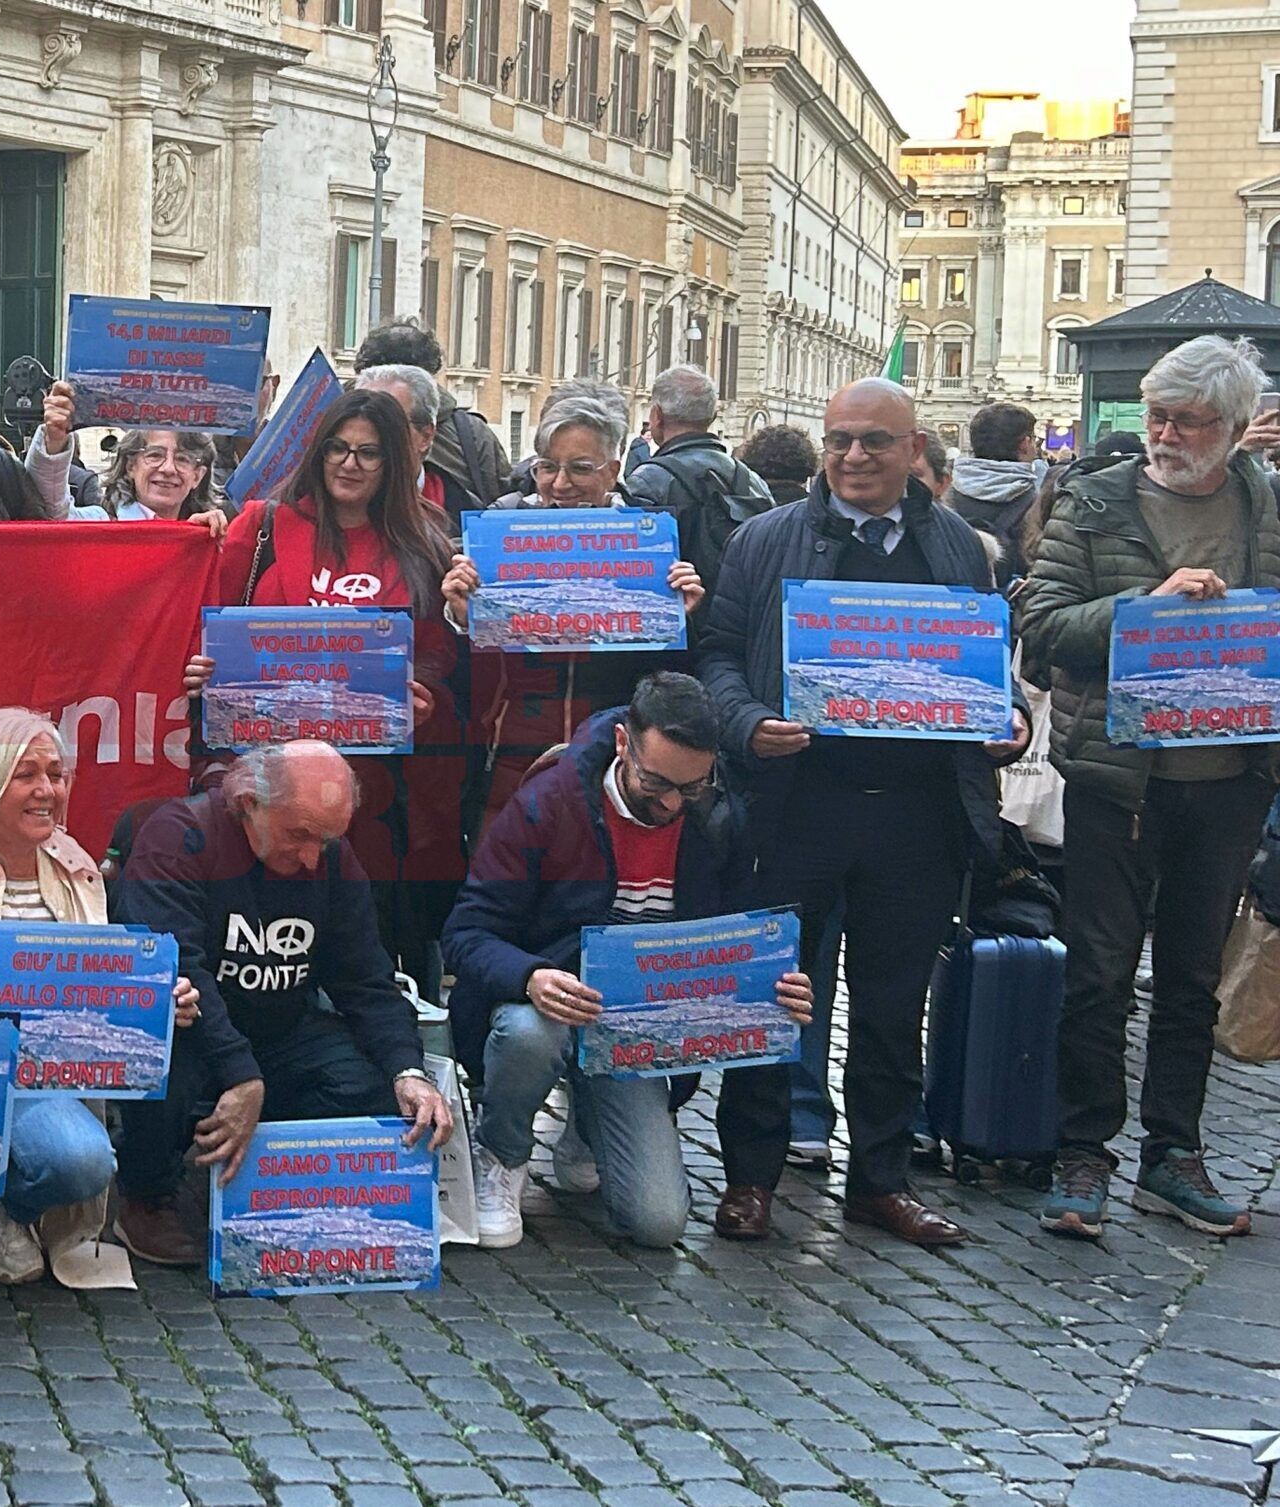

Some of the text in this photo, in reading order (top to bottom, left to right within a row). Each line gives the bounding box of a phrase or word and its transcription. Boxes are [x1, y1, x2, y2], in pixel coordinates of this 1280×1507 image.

[107, 323, 231, 344] 14,6 MILIARDI
[127, 349, 206, 367] DI TASSE
[119, 373, 209, 391] PER TUTTI
[96, 402, 218, 423] NO PONTE
[503, 534, 639, 553] SIAMO TUTTI
[497, 560, 654, 581] ESPROPRIANDI
[511, 612, 644, 635] NO PONTE
[794, 613, 832, 630] TRA
[835, 615, 899, 633] SCILLA
[902, 616, 913, 633] E
[250, 634, 364, 653] VOGLIAMO
[830, 639, 961, 660] SOLO IL MARE
[260, 663, 350, 682] L'ACQUA
[826, 698, 967, 725] NO PONTE
[1143, 705, 1272, 732] NO PONTE
[232, 719, 271, 740] NO
[298, 719, 382, 740] PONTE
[225, 912, 315, 961] NO
[56, 952, 78, 972] LE
[81, 953, 134, 973] MANI
[636, 943, 753, 972] VOGLIAMO
[216, 959, 310, 991] PONTE
[63, 985, 156, 1008] STRETTO
[645, 975, 737, 1001] L'ACQUA
[612, 1043, 655, 1066] NO
[681, 1027, 767, 1057] PONTE
[42, 1062, 127, 1086] PONTE
[258, 1151, 397, 1177] SIAMO TUTTI
[250, 1184, 411, 1210] ESPROPRIANDI
[261, 1246, 396, 1274] NO PONTE
